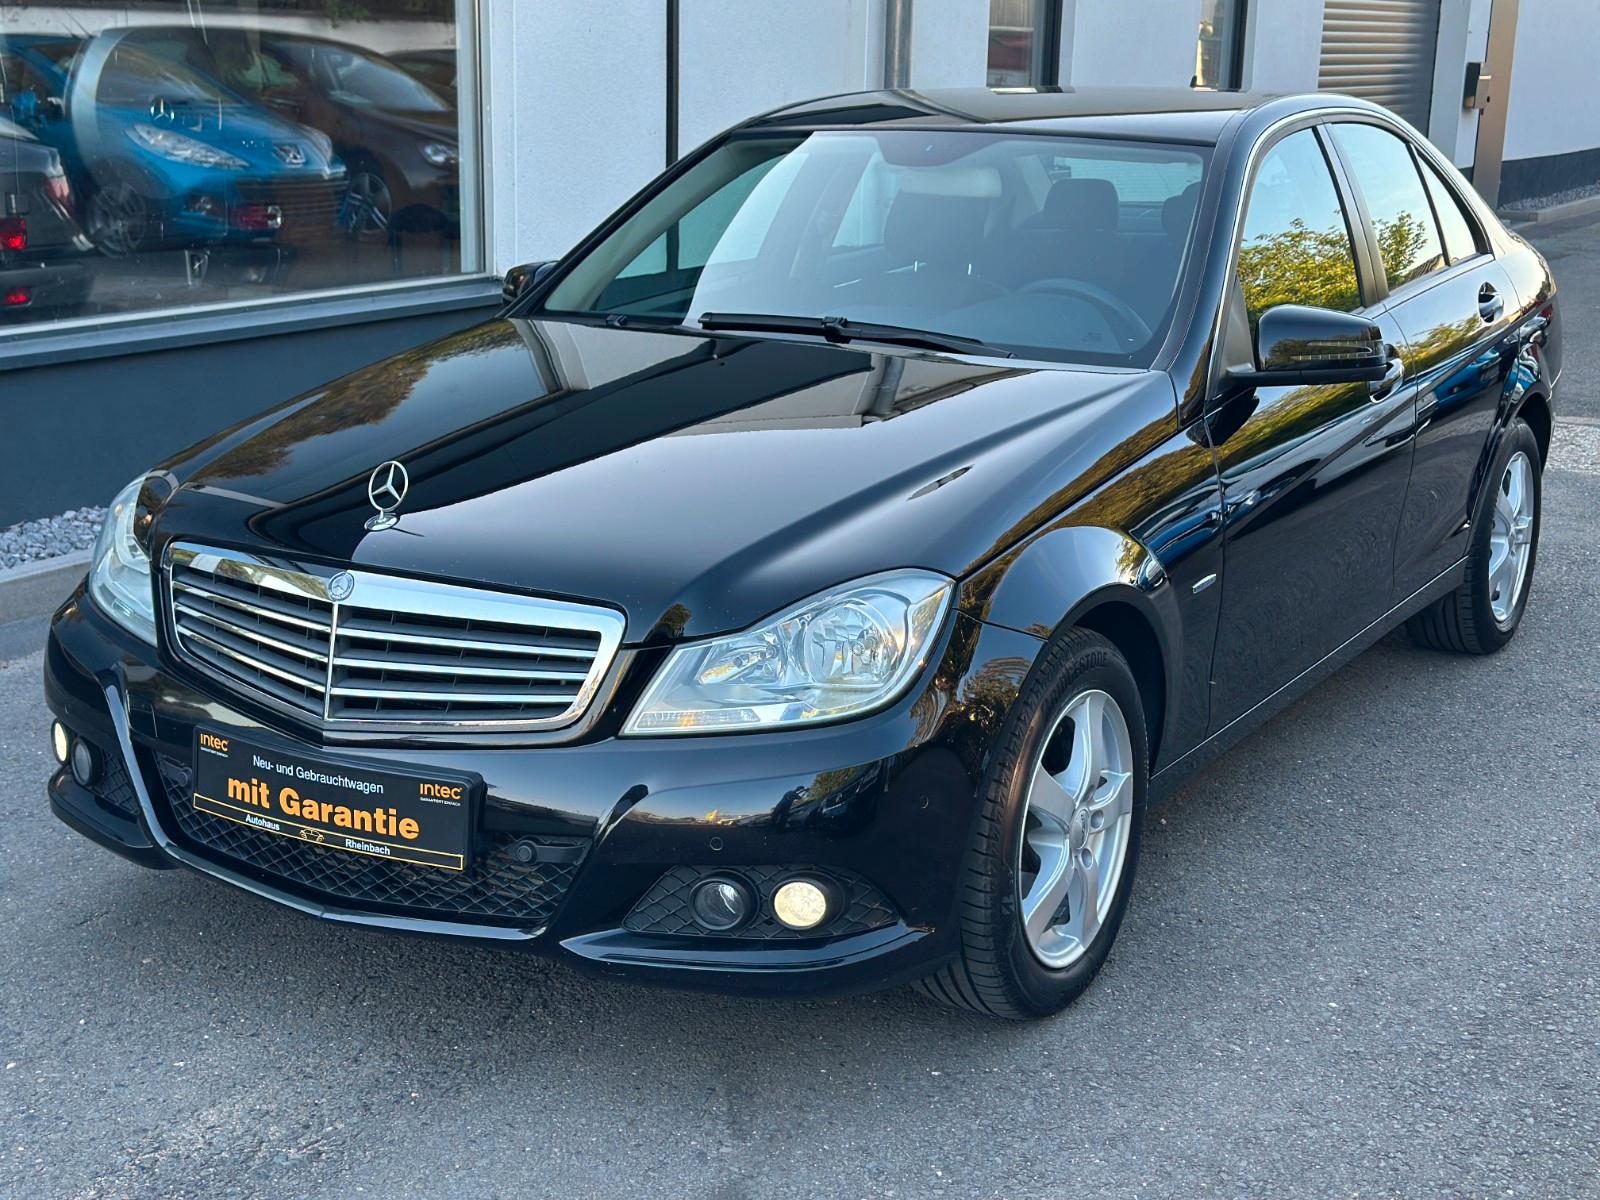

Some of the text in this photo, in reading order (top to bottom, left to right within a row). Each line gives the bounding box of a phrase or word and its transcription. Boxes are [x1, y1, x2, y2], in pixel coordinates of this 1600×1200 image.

[200, 733, 229, 752] intec
[252, 754, 384, 794] Neu- und Gebrauchtwagen
[419, 783, 462, 800] intec
[227, 777, 420, 840] mit Garantie
[245, 813, 391, 855] Autohaus Rheinbach
